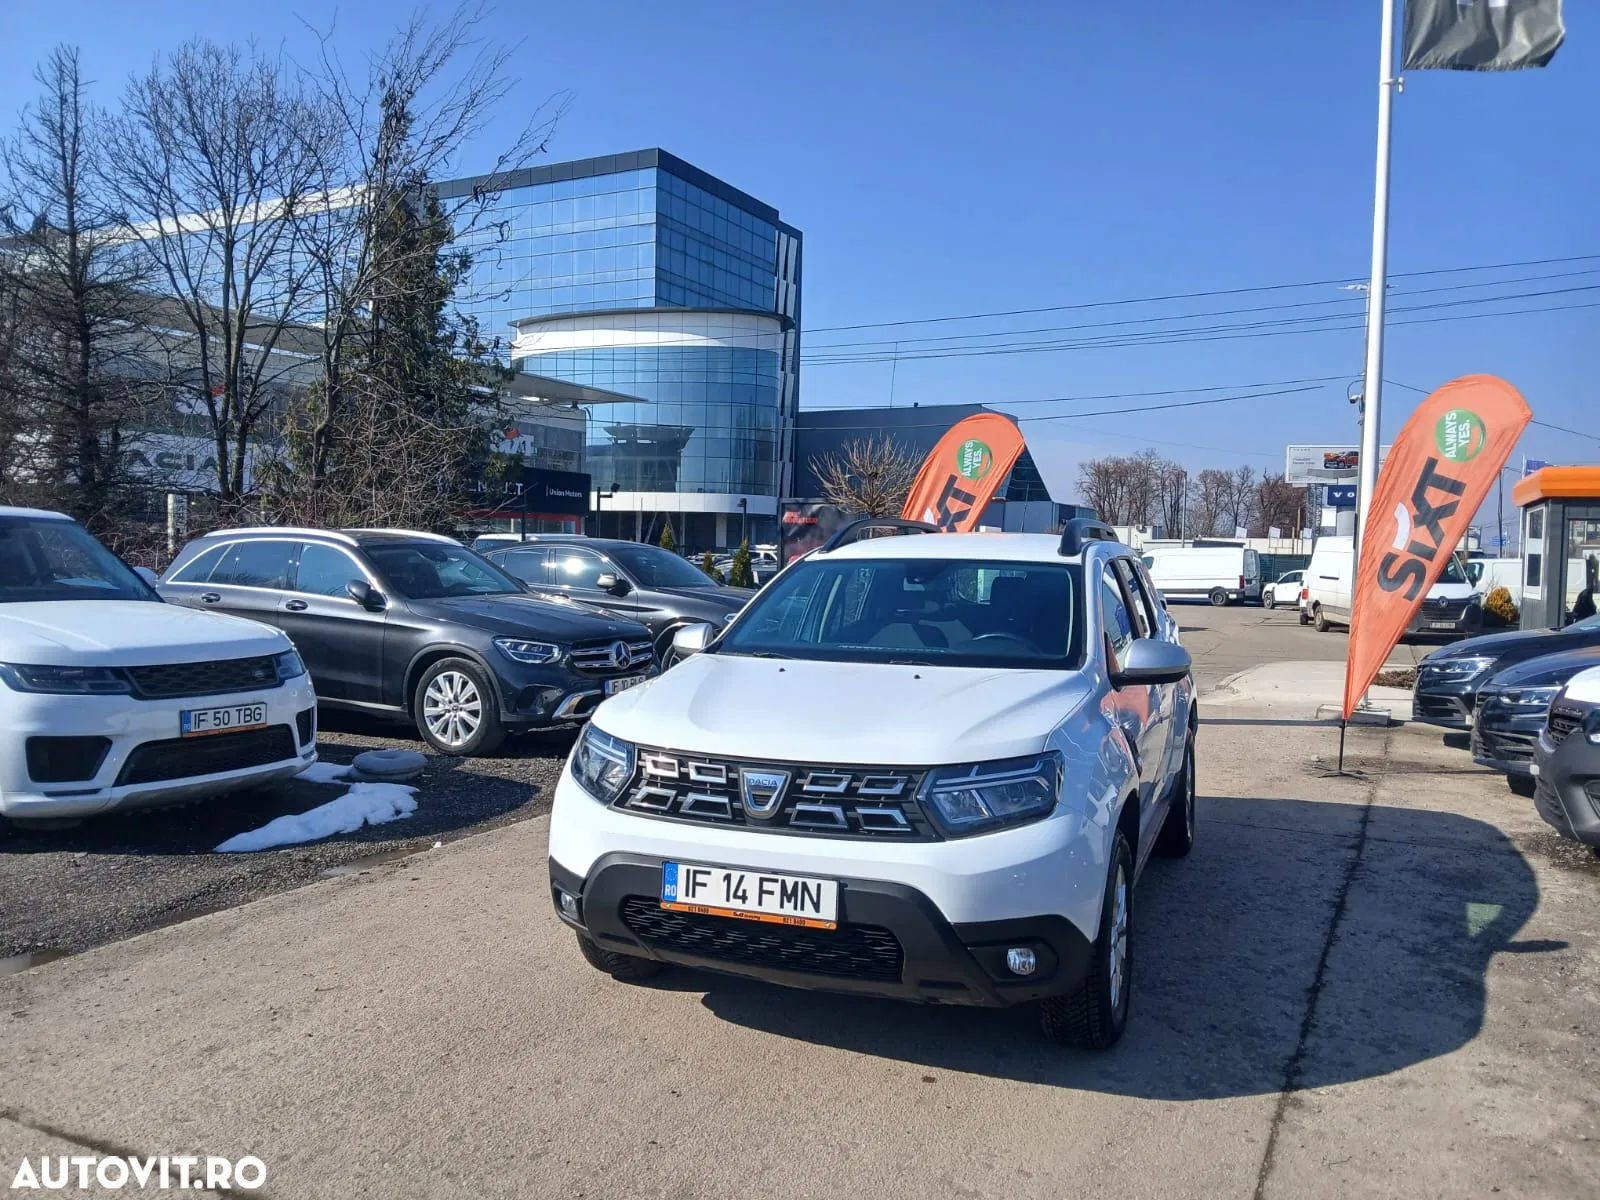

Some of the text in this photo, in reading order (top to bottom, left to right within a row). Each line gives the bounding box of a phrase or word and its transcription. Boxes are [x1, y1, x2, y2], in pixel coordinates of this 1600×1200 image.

[1445, 412, 1456, 457] ALWAYS
[1458, 420, 1470, 447] YES.
[962, 441, 974, 476] ALWAYS
[549, 489, 582, 498] Union Motors
[1378, 457, 1467, 601] SIXT
[195, 712, 208, 730] IF
[213, 710, 231, 727] 50
[236, 707, 262, 724] TBG
[748, 778, 777, 786] DACIA
[665, 868, 822, 913] RO IF 14 FMN
